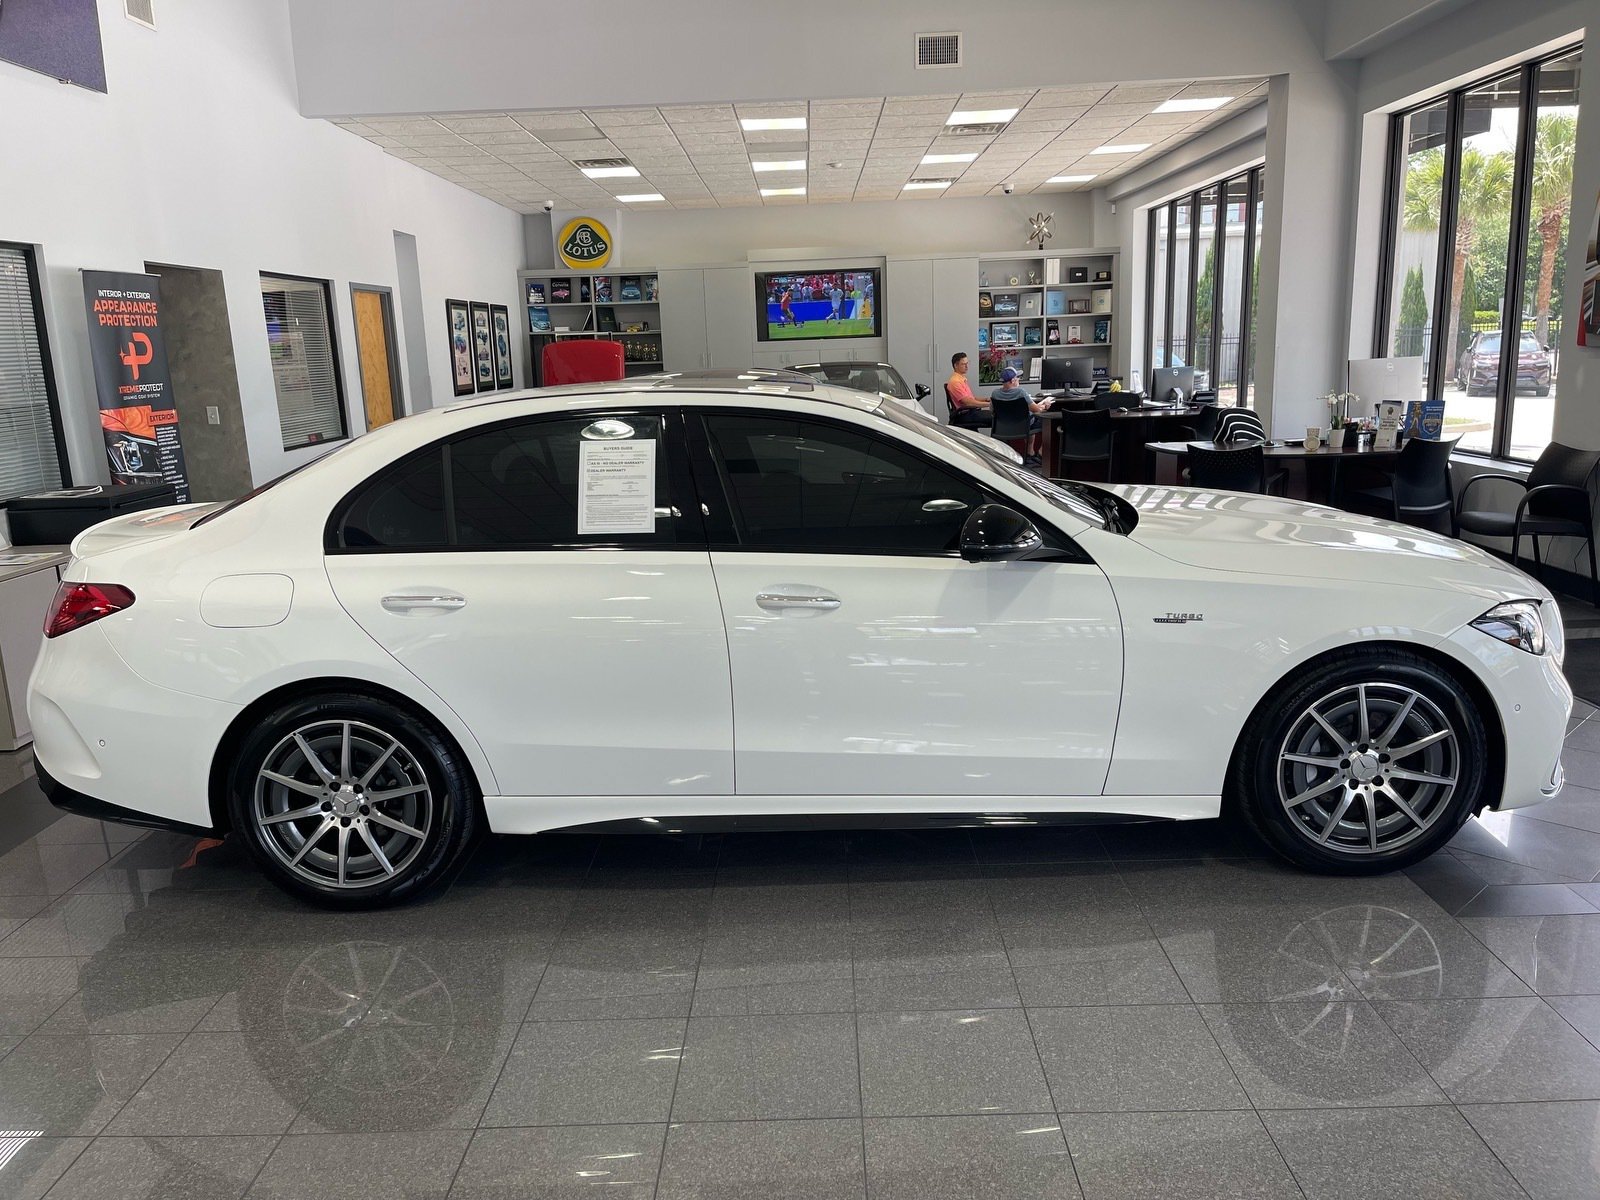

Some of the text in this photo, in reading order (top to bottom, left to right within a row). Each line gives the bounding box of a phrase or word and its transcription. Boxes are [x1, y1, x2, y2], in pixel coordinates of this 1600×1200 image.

[565, 241, 606, 257] LOTUS
[98, 289, 122, 298] INTERIOR
[126, 291, 151, 299] EXTERIOR
[93, 299, 158, 314] APPEARANCE
[98, 313, 158, 327] PROTECTION
[149, 413, 175, 423] EXTERIOR
